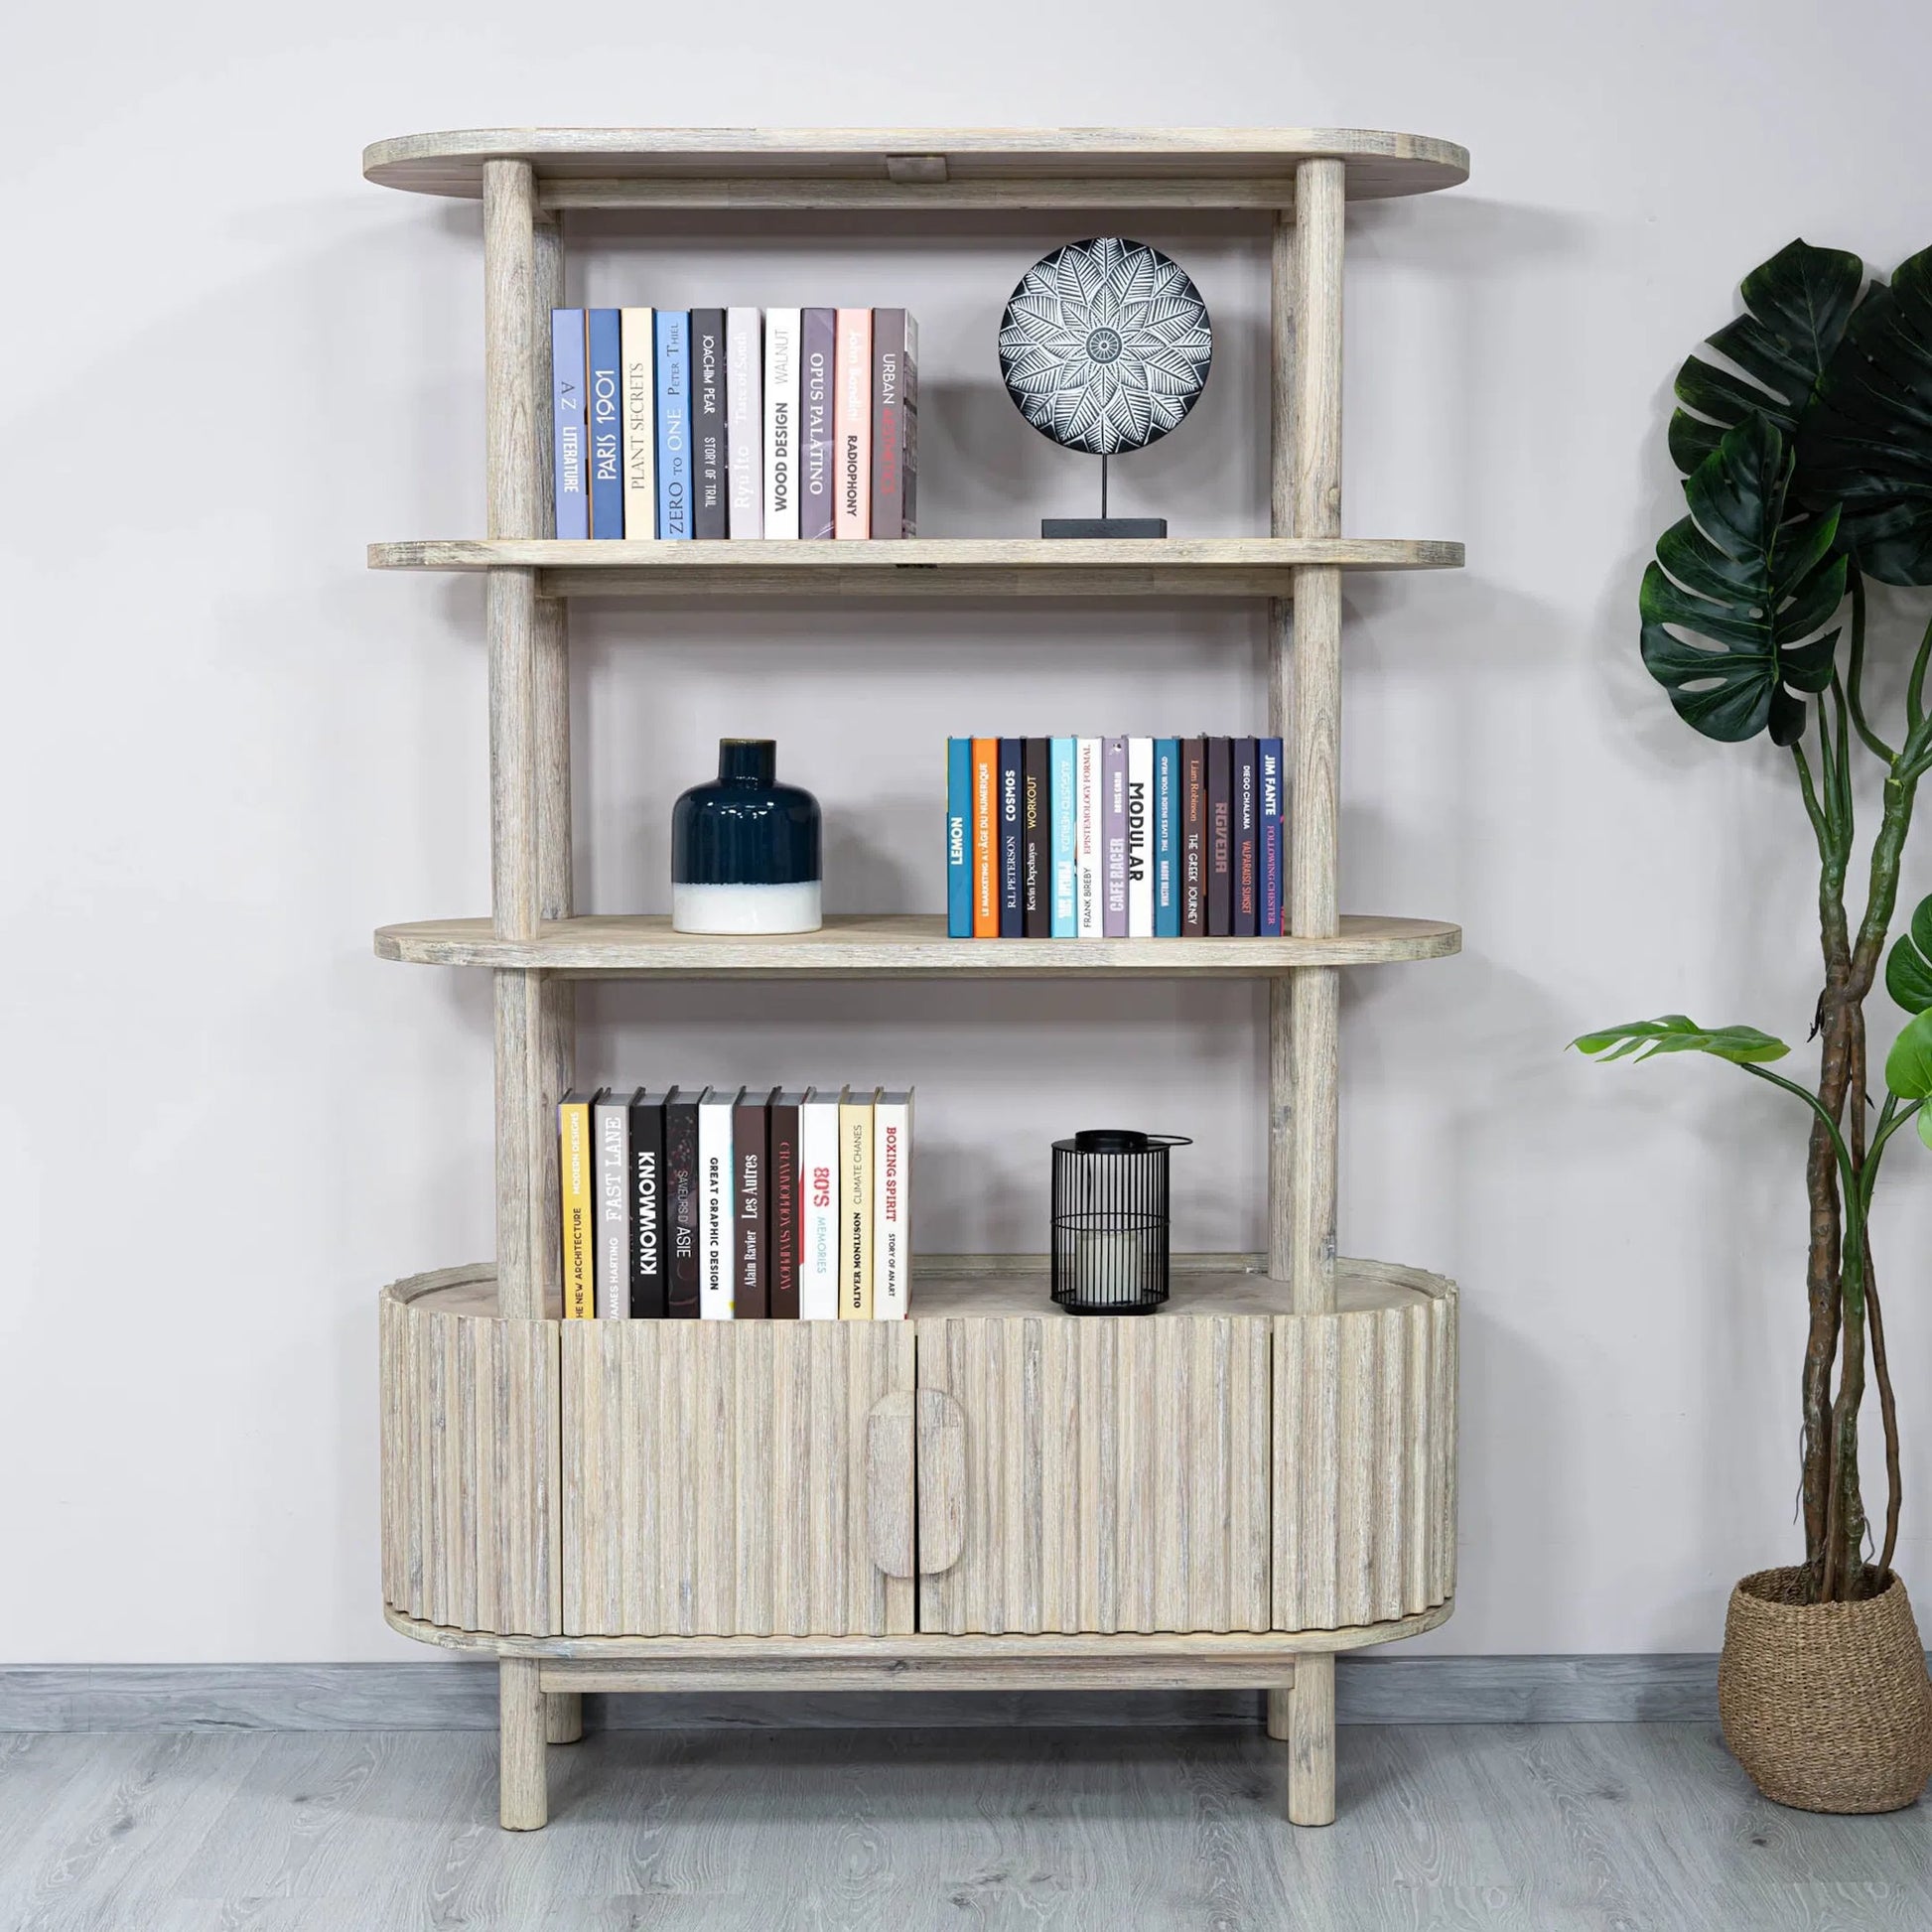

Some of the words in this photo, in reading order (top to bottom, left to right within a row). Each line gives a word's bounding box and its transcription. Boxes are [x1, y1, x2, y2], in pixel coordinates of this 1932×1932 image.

[703, 336, 714, 383] JOACHIM
[775, 330, 788, 385] WALNUT
[810, 352, 824, 401] OPUS
[561, 381, 576, 394] A
[596, 370, 616, 424] 1901
[629, 362, 643, 431] SECRETS
[883, 354, 896, 404] URBAN
[562, 398, 577, 410] Z
[704, 387, 715, 414] PEAR
[667, 409, 681, 451] ONE
[775, 403, 788, 458] DESIGN
[810, 405, 824, 495] PALATINO
[562, 426, 579, 492] LITERATURE
[598, 435, 617, 480] PARIS
[631, 436, 644, 489] PLANT
[705, 437, 715, 466] STORY
[705, 470, 716, 480] OF
[706, 483, 717, 506] TRAIL
[735, 475, 754, 508] Ryu
[774, 464, 788, 511] WOOD
[847, 436, 858, 516] RADIOPHONY
[669, 483, 684, 534] ZERO
[1190, 760, 1199, 779] Liam
[1265, 755, 1275, 775] JIM
[978, 762, 989, 815] NUMERIQUE
[1006, 770, 1016, 821] COSMOS
[1028, 776, 1036, 828] WORKOUT
[1190, 782, 1199, 821] Robinson
[1266, 778, 1276, 816] FANTE
[951, 817, 963, 865] LEMON
[980, 817, 988, 828] DU
[1130, 782, 1144, 881] MODULAR
[1188, 834, 1198, 849] THE
[1215, 802, 1228, 874] RGVEDA
[1110, 838, 1124, 876] RACER
[1188, 853, 1198, 882] GREEK
[1242, 842, 1251, 885] VALPARAISO
[981, 863, 990, 906] MARKETING
[1027, 885, 1035, 910] Kevin
[1110, 878, 1125, 910] CAFE
[1188, 886, 1198, 924] JOURNEY
[1242, 887, 1251, 914] SUNSET
[605, 1117, 621, 1167] LANE
[886, 1127, 897, 1176] BOXING
[573, 1155, 582, 1194] MODERN
[677, 1171, 688, 1214] SAVEURS
[710, 1158, 719, 1194] GREAT
[743, 1155, 758, 1194] Autres
[814, 1167, 829, 1207] 80'S
[606, 1173, 621, 1221] FAST
[742, 1197, 758, 1219] Les
[886, 1179, 897, 1222] SPIRIT
[574, 1208, 583, 1278] ARCHITECTURE
[677, 1226, 691, 1258] ASIE
[710, 1199, 719, 1246] GRAPHIC
[610, 1237, 619, 1283] HARTING
[745, 1230, 757, 1260] Ravier
[816, 1217, 826, 1274] MEMORIES
[889, 1259, 896, 1268] OF
[710, 1250, 719, 1290] DESIGN
[745, 1262, 757, 1287] Alain
[890, 1270, 896, 1282] AN
[610, 1287, 620, 1320] JAMES
